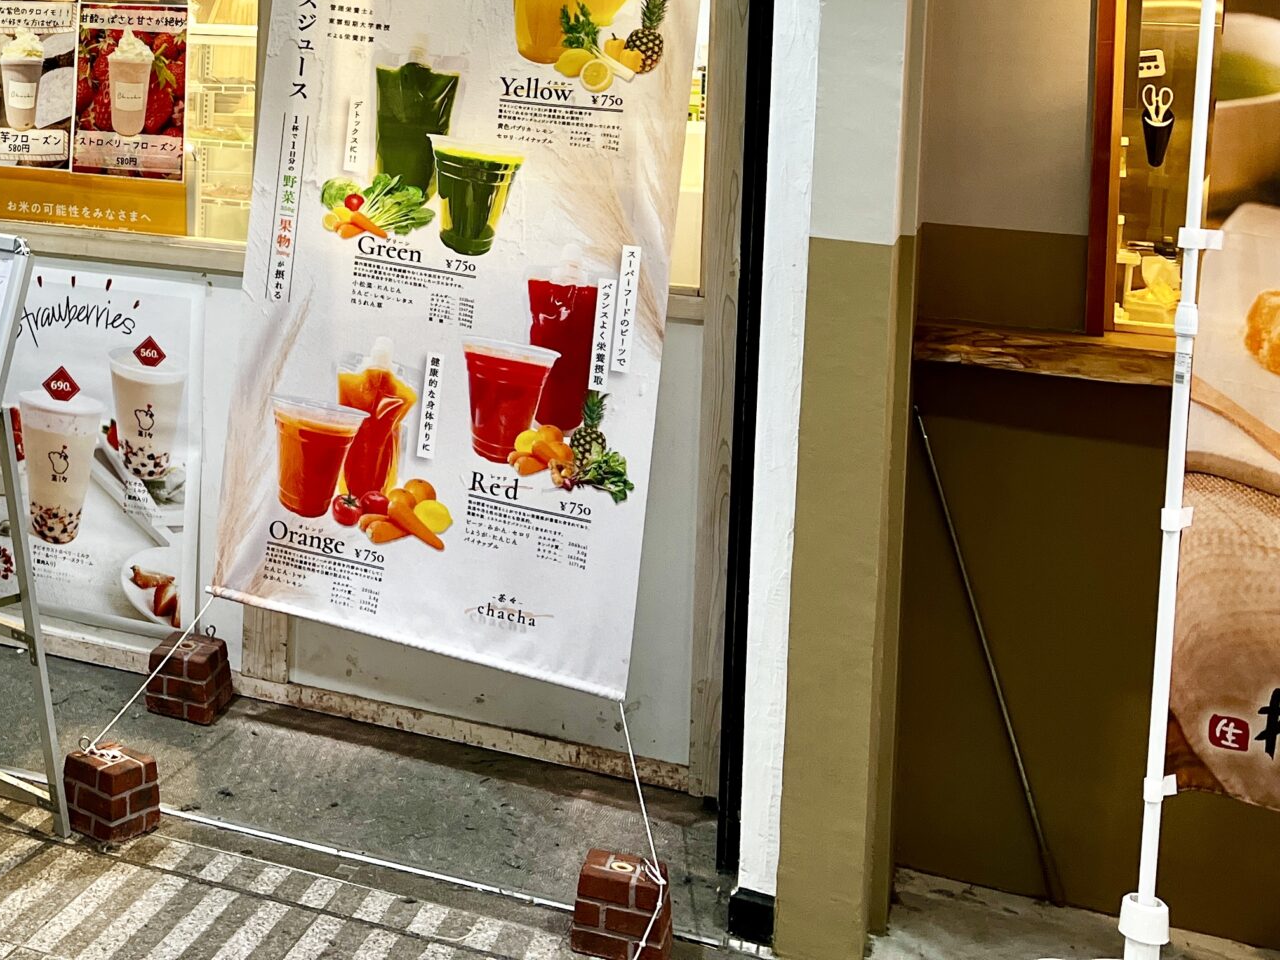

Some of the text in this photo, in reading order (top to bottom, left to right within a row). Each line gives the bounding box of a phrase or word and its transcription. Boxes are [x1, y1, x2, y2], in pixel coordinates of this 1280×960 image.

[500, 76, 574, 101] Yellow
[591, 94, 624, 107] ¥750
[8, 144, 30, 153] 580円
[79, 136, 177, 152] ストロベリーフローズン
[116, 157, 138, 166] 580円
[6, 200, 152, 223] お米の可能性をみなさまへ
[358, 235, 422, 263] Green
[446, 259, 476, 272] ¥750
[617, 251, 636, 366] スーパーフードのビーツで
[422, 356, 440, 451] 健康的な身体作りに
[468, 471, 519, 500] Red
[560, 501, 591, 516] ¥750
[269, 520, 345, 554] Orange
[354, 548, 385, 563] ¥750
[477, 602, 536, 627] chacha
